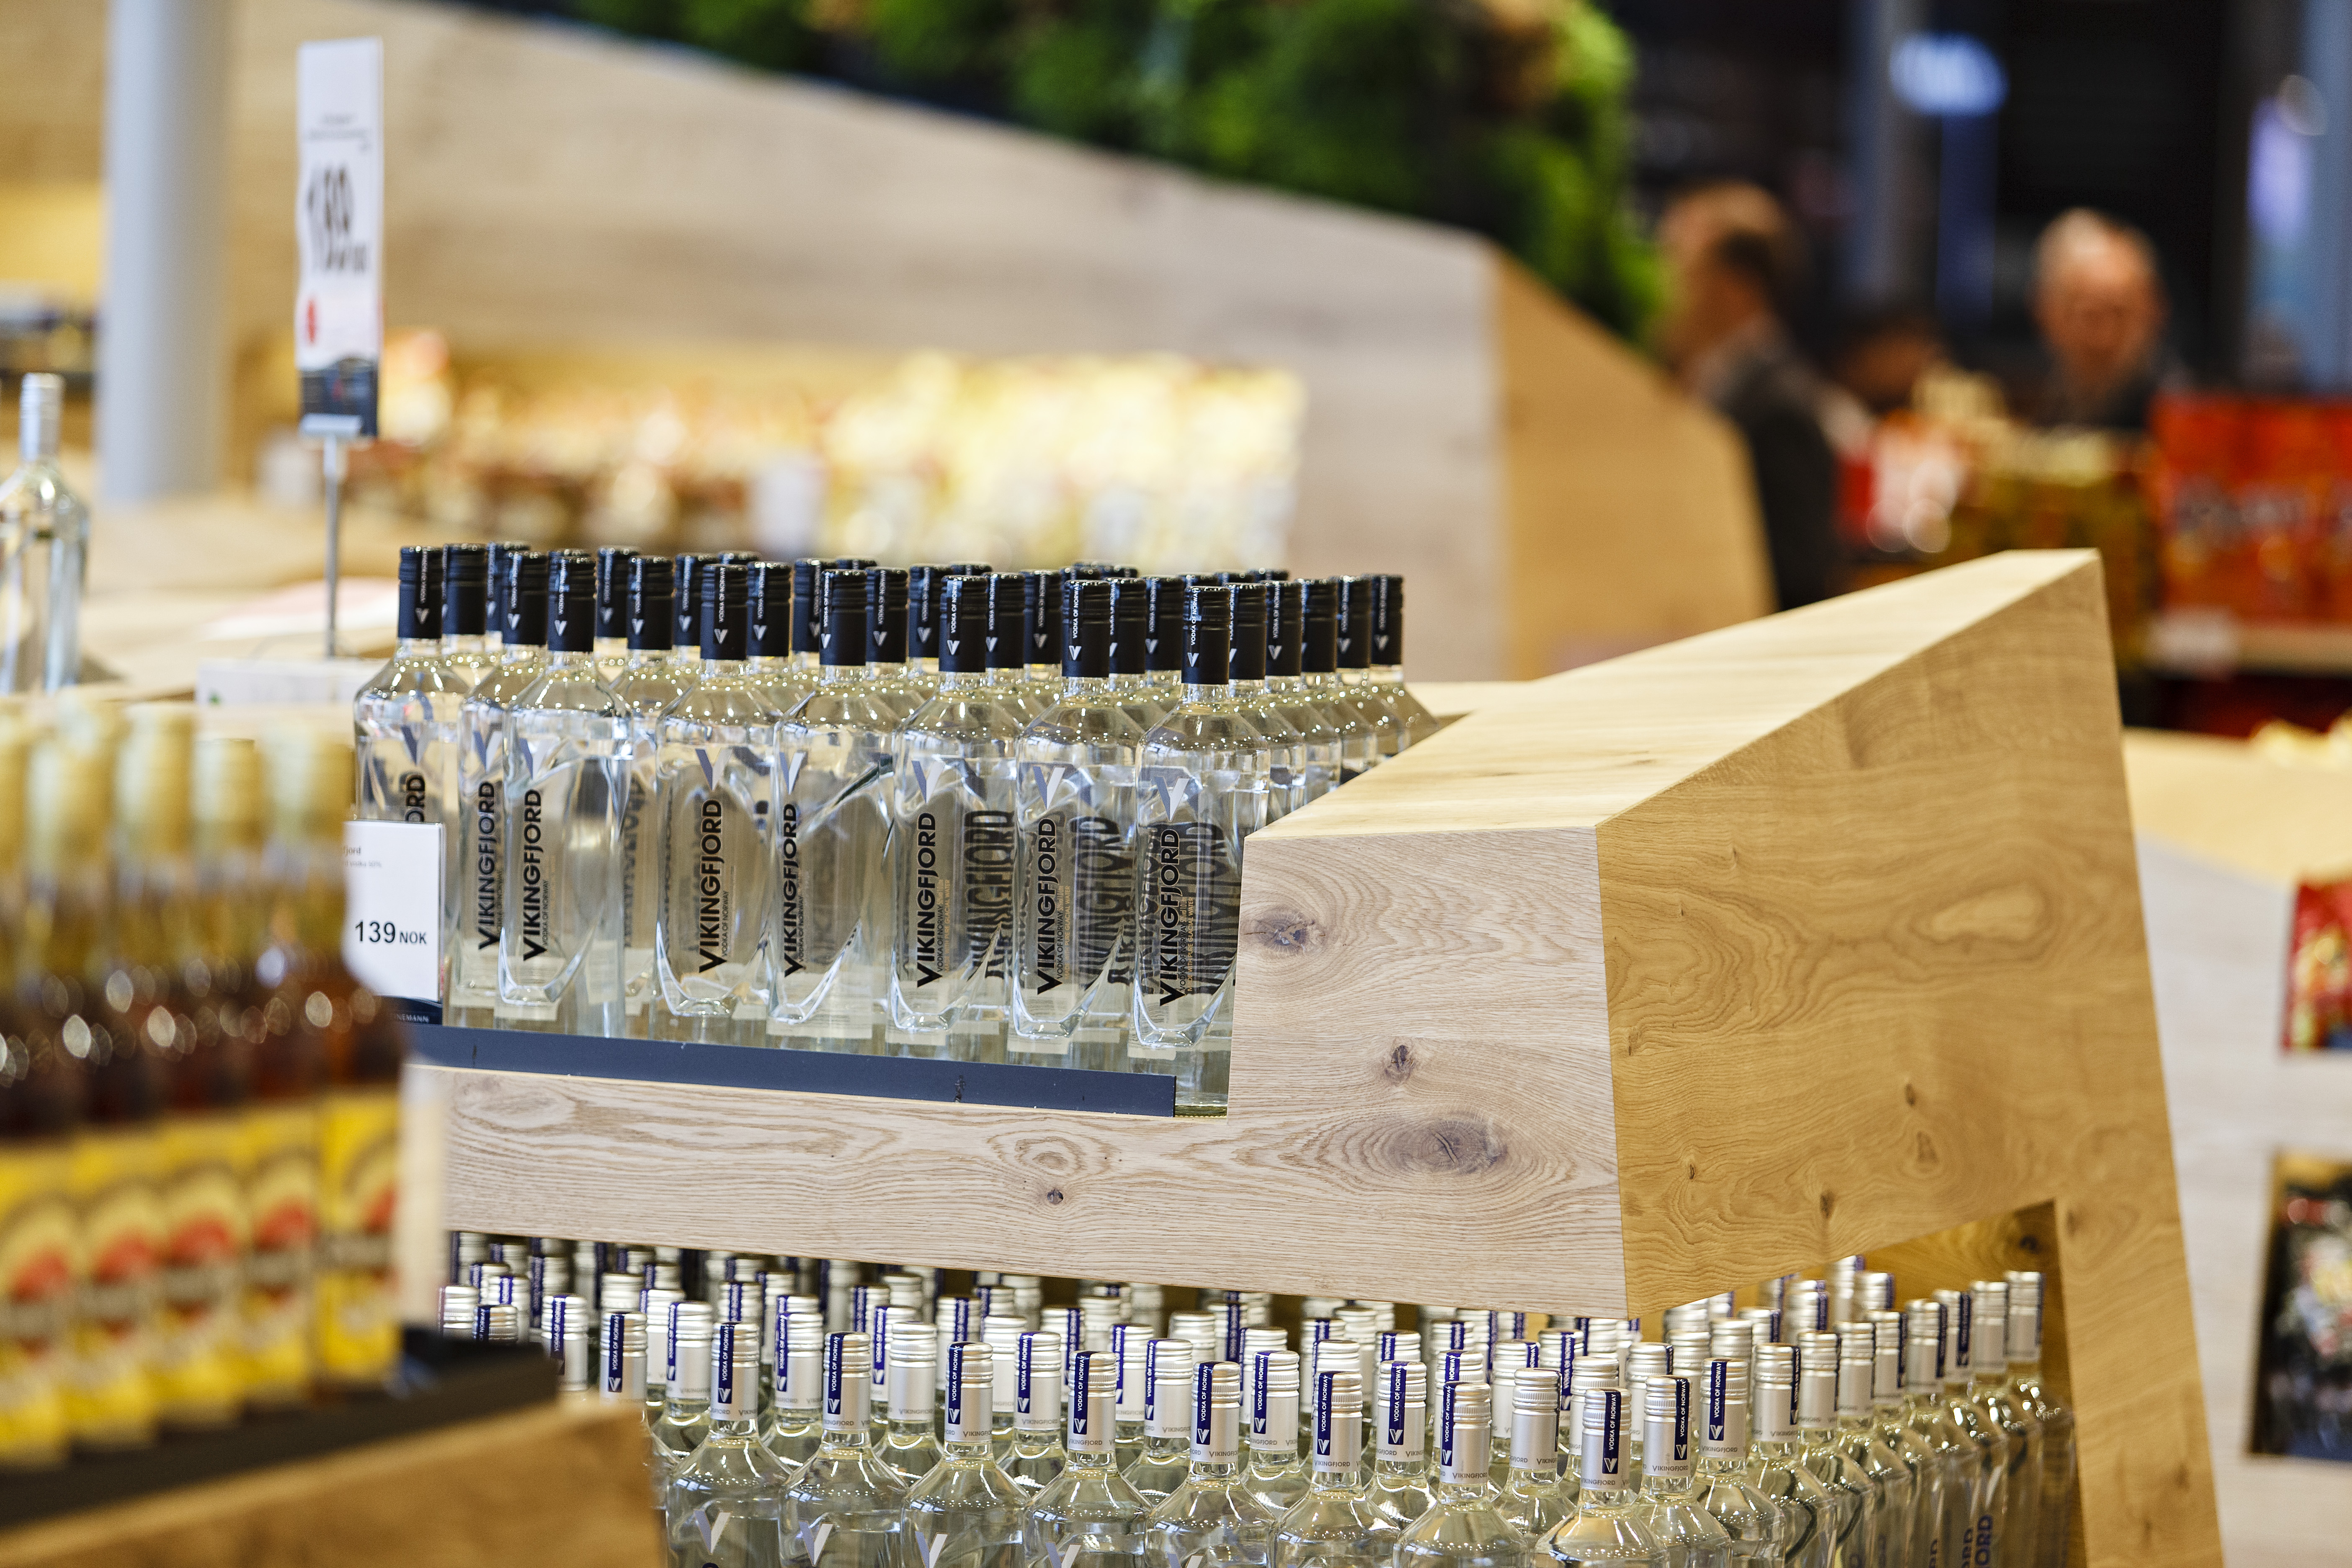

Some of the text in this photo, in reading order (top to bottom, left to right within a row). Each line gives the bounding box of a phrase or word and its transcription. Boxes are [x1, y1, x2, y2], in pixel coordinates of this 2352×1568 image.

[951, 603, 957, 612] OF
[1073, 609, 1079, 617] OF
[1191, 615, 1196, 624] OF
[478, 781, 500, 950] VIKINGFJORD
[523, 789, 547, 962] VIKINGFJORD
[699, 799, 727, 973] VIKINGFJORD
[784, 804, 804, 977] VIKINGFJORD
[917, 812, 943, 988] VIKINGFJORD
[1037, 818, 1063, 995] VIKINGFJORD
[1160, 829, 1186, 1006] VIKINGFJORD
[722, 922, 728, 931] OF
[355, 921, 427, 944] 139 NOK
[937, 936, 943, 946] OF
[1057, 943, 1063, 952] OF
[1180, 955, 1186, 964] OF
[1021, 1361, 1026, 1369] OF
[952, 1372, 957, 1380] OF
[1147, 1368, 1152, 1376] OF
[1202, 1391, 1207, 1400] OF
[1610, 1420, 1615, 1429] OF
